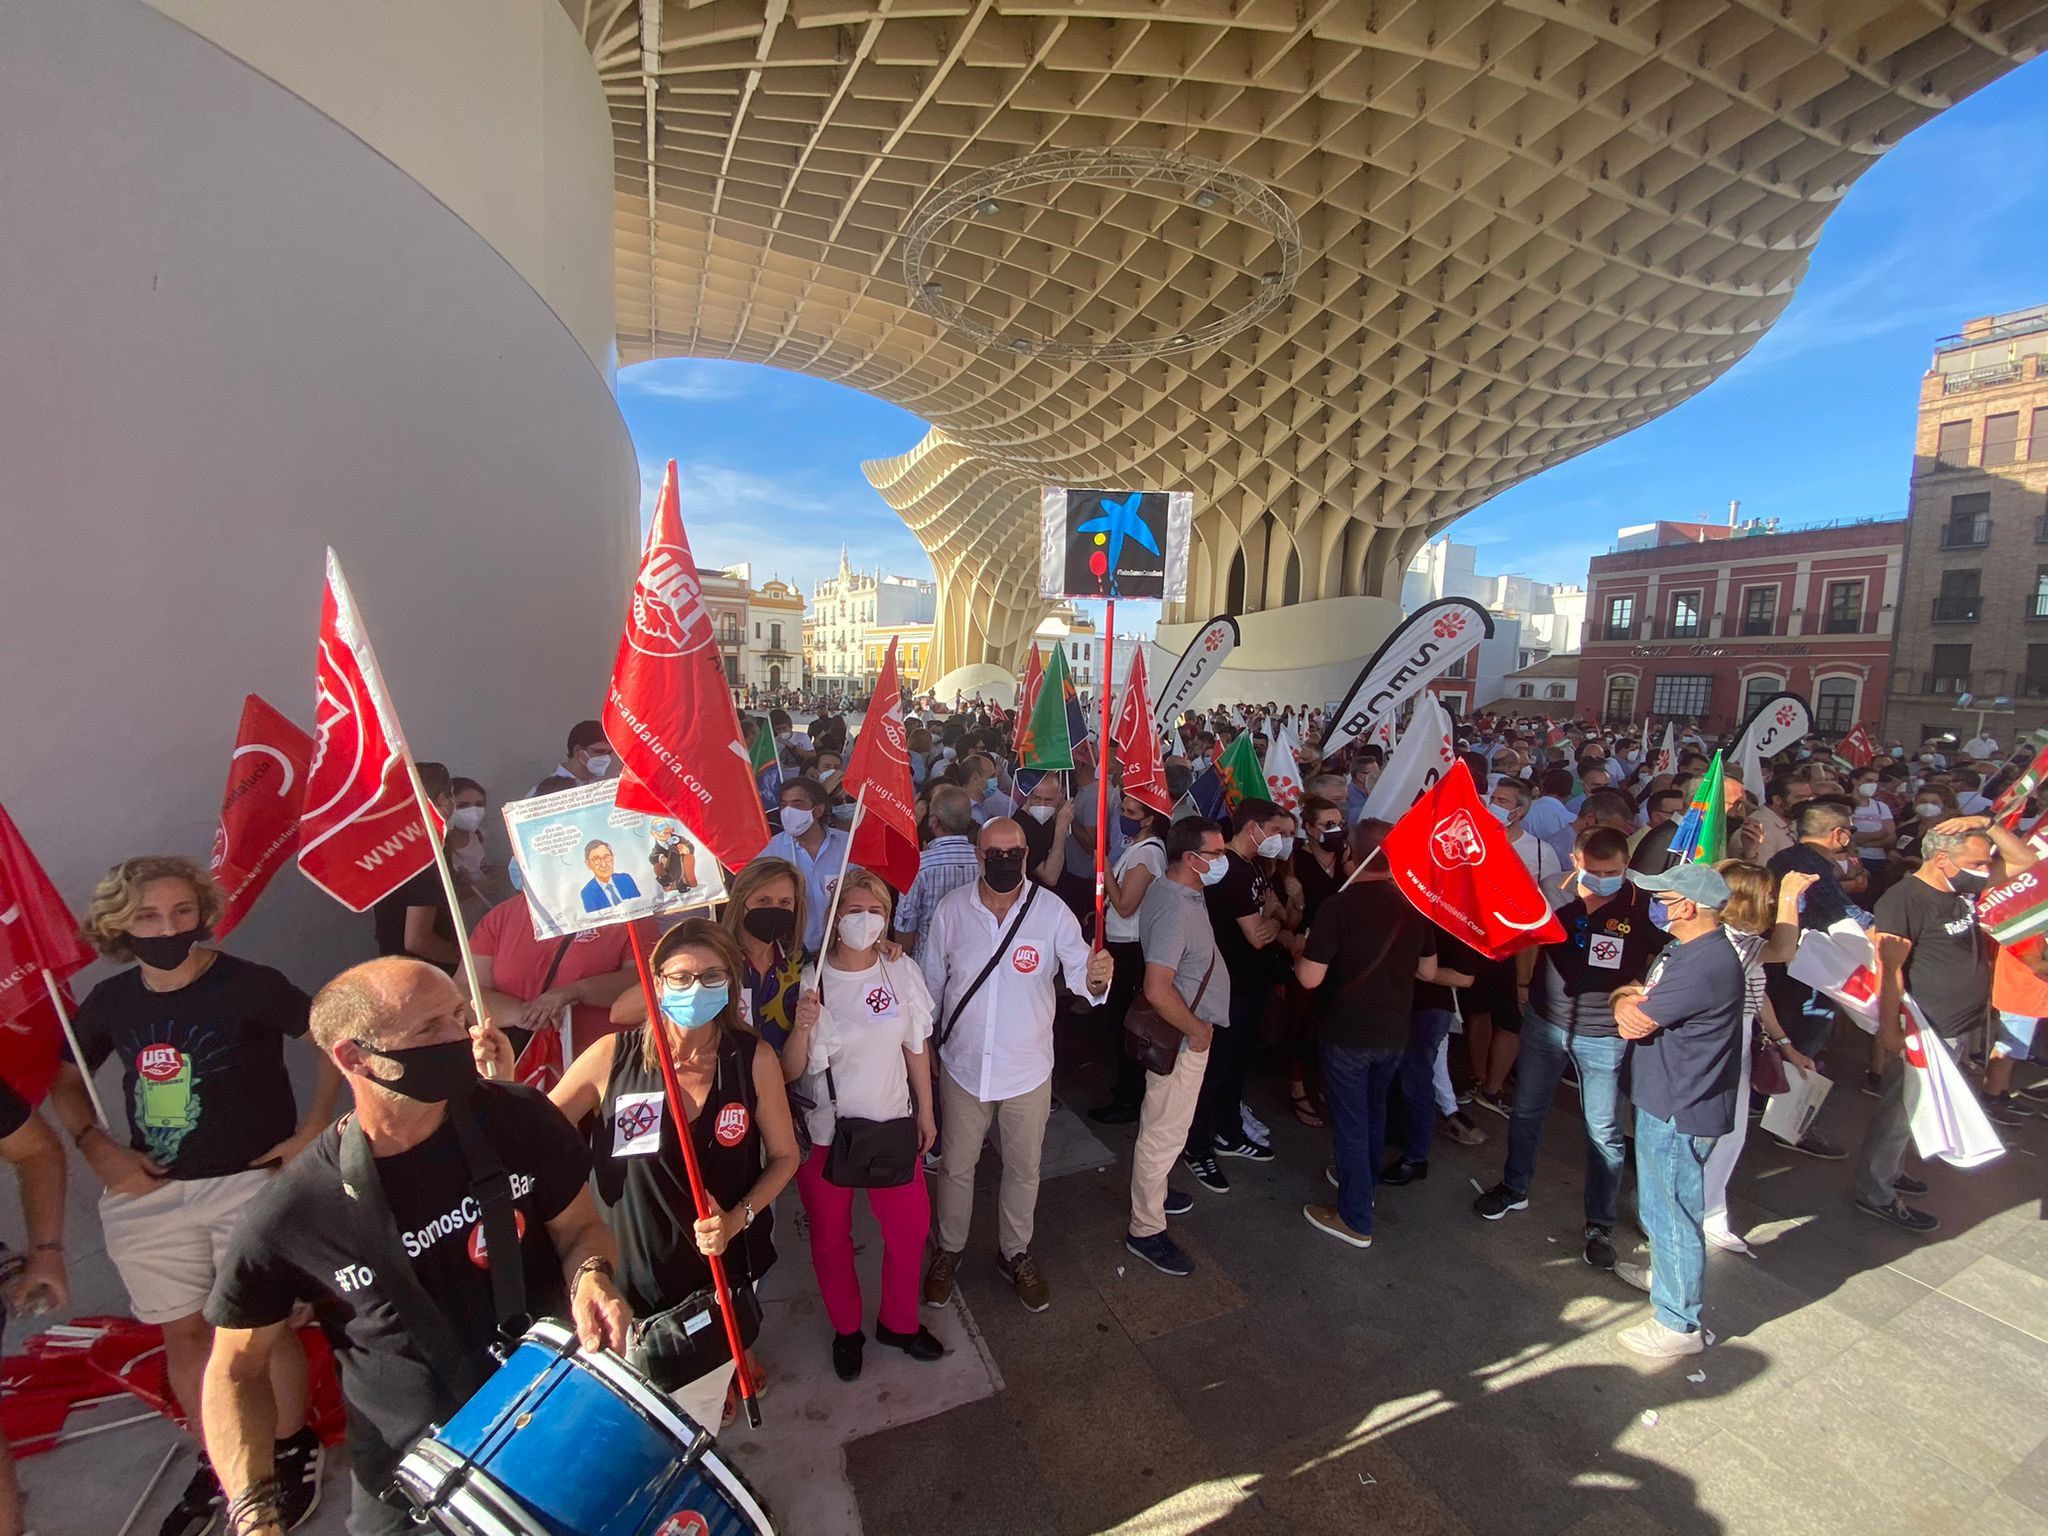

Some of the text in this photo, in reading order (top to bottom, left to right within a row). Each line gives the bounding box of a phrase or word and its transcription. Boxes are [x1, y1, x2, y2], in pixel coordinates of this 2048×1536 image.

[640, 552, 708, 633] UGT
[1341, 643, 1440, 736] SECB
[1016, 949, 1036, 961] UGT
[143, 1048, 175, 1066] UGT
[720, 1109, 745, 1126] UGT
